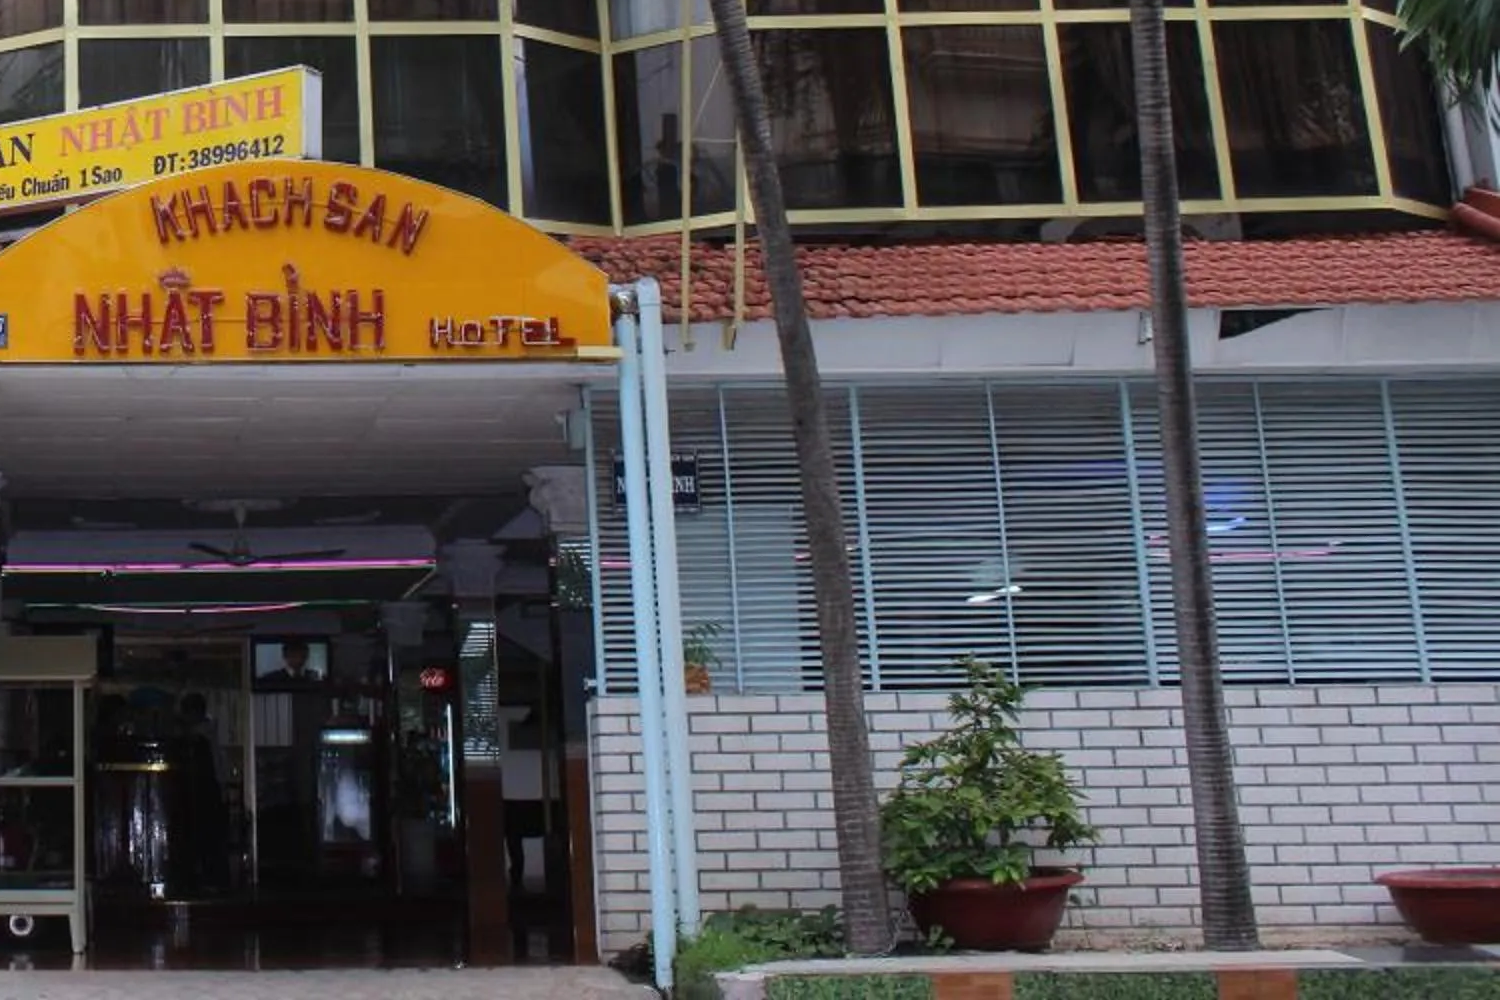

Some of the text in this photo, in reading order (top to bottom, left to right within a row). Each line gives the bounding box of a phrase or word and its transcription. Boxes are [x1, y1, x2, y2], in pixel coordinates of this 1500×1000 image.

[182, 84, 287, 135] BÌNH
[153, 135, 285, 175] ĐT:38996412
[150, 176, 430, 256] KHACH SAN
